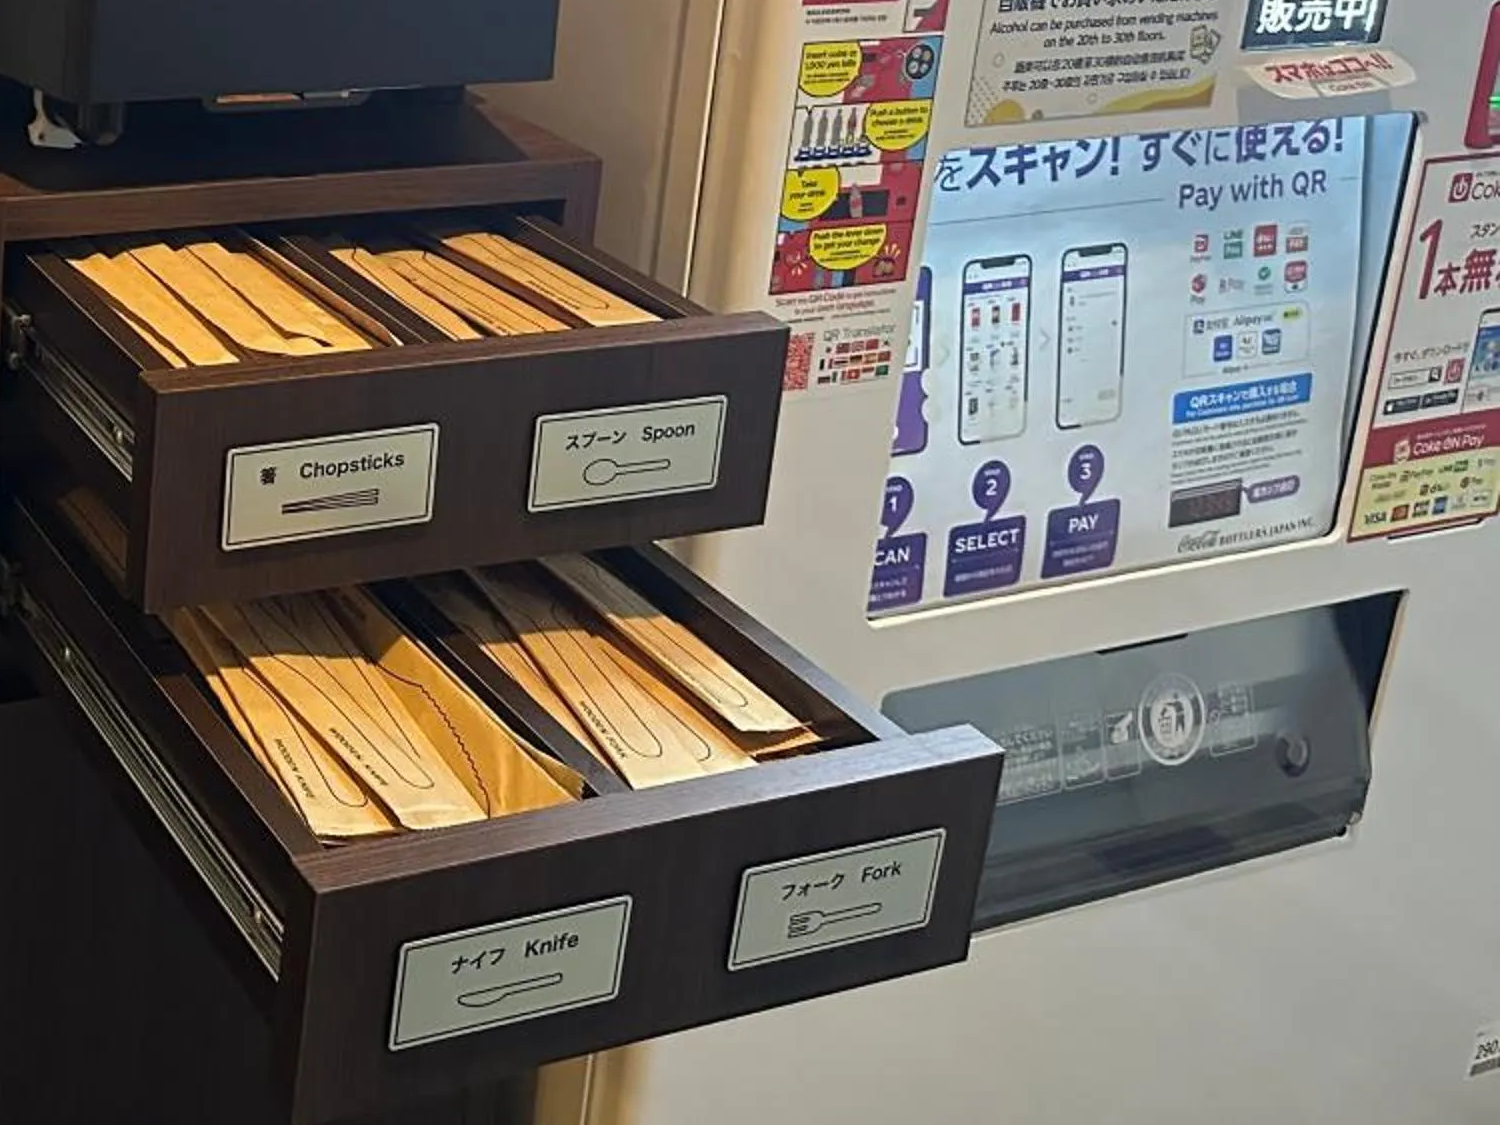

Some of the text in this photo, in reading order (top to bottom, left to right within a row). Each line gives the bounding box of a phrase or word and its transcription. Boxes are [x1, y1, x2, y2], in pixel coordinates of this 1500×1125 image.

[990, 20, 1029, 35] Alcohol
[1030, 22, 1048, 32] can
[1050, 20, 1062, 31] be
[1064, 16, 1114, 32] purchased
[1116, 15, 1137, 26] from
[1176, 11, 1218, 22] machines
[1044, 39, 1056, 48] on
[1059, 36, 1074, 47] the
[1076, 35, 1099, 46] 20th
[1101, 35, 1112, 45] to
[1113, 32, 1135, 44] 30th
[1178, 170, 1327, 210] Pay with QR
[1419, 219, 1500, 299] 1本無
[565, 422, 696, 452] スプーン Spoon
[1462, 435, 1485, 449] Pay
[260, 450, 405, 486] 箸 Chopsticks
[1081, 464, 1092, 480] 3
[986, 480, 997, 495] 2
[890, 497, 898, 512] 1
[1068, 515, 1099, 533] PAY
[1220, 527, 1267, 547] BOTTLERS
[1269, 521, 1296, 538] JAPAN
[955, 529, 1020, 553] SELECT
[781, 862, 901, 901] フォーク Fork
[452, 930, 581, 975] ナイフ Knife
